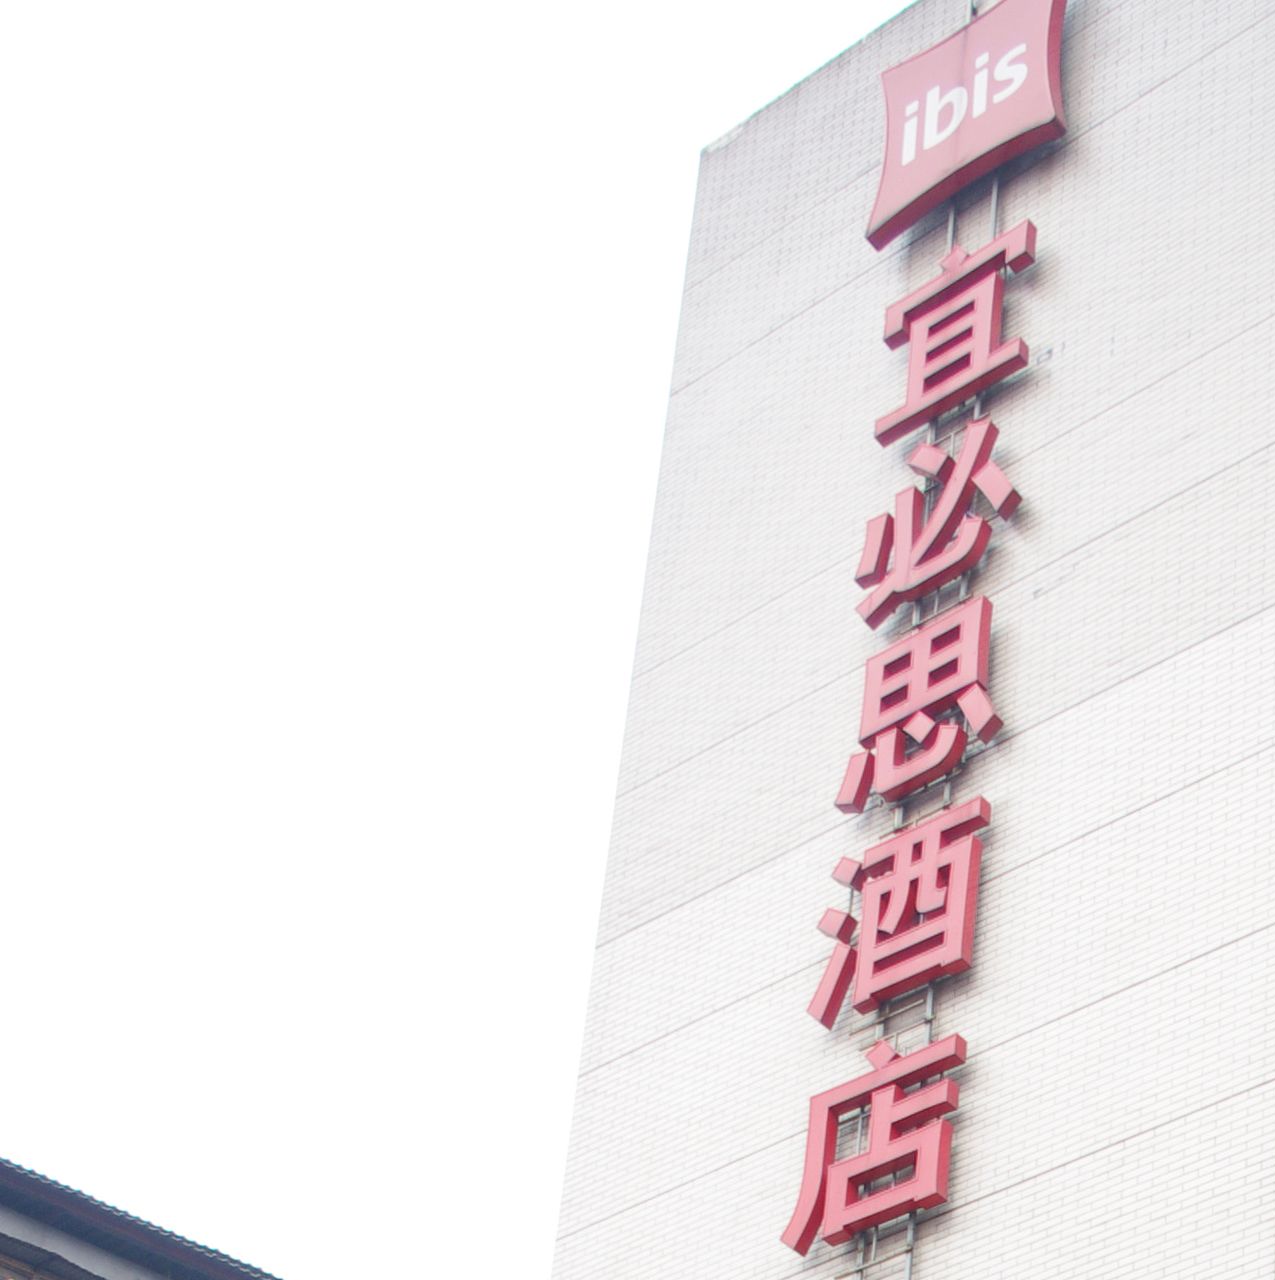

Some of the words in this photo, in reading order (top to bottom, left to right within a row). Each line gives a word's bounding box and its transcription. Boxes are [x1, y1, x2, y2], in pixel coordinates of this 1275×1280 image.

[901, 43, 1028, 165] ibis
[780, 219, 1037, 1256] 宜必思酒店
